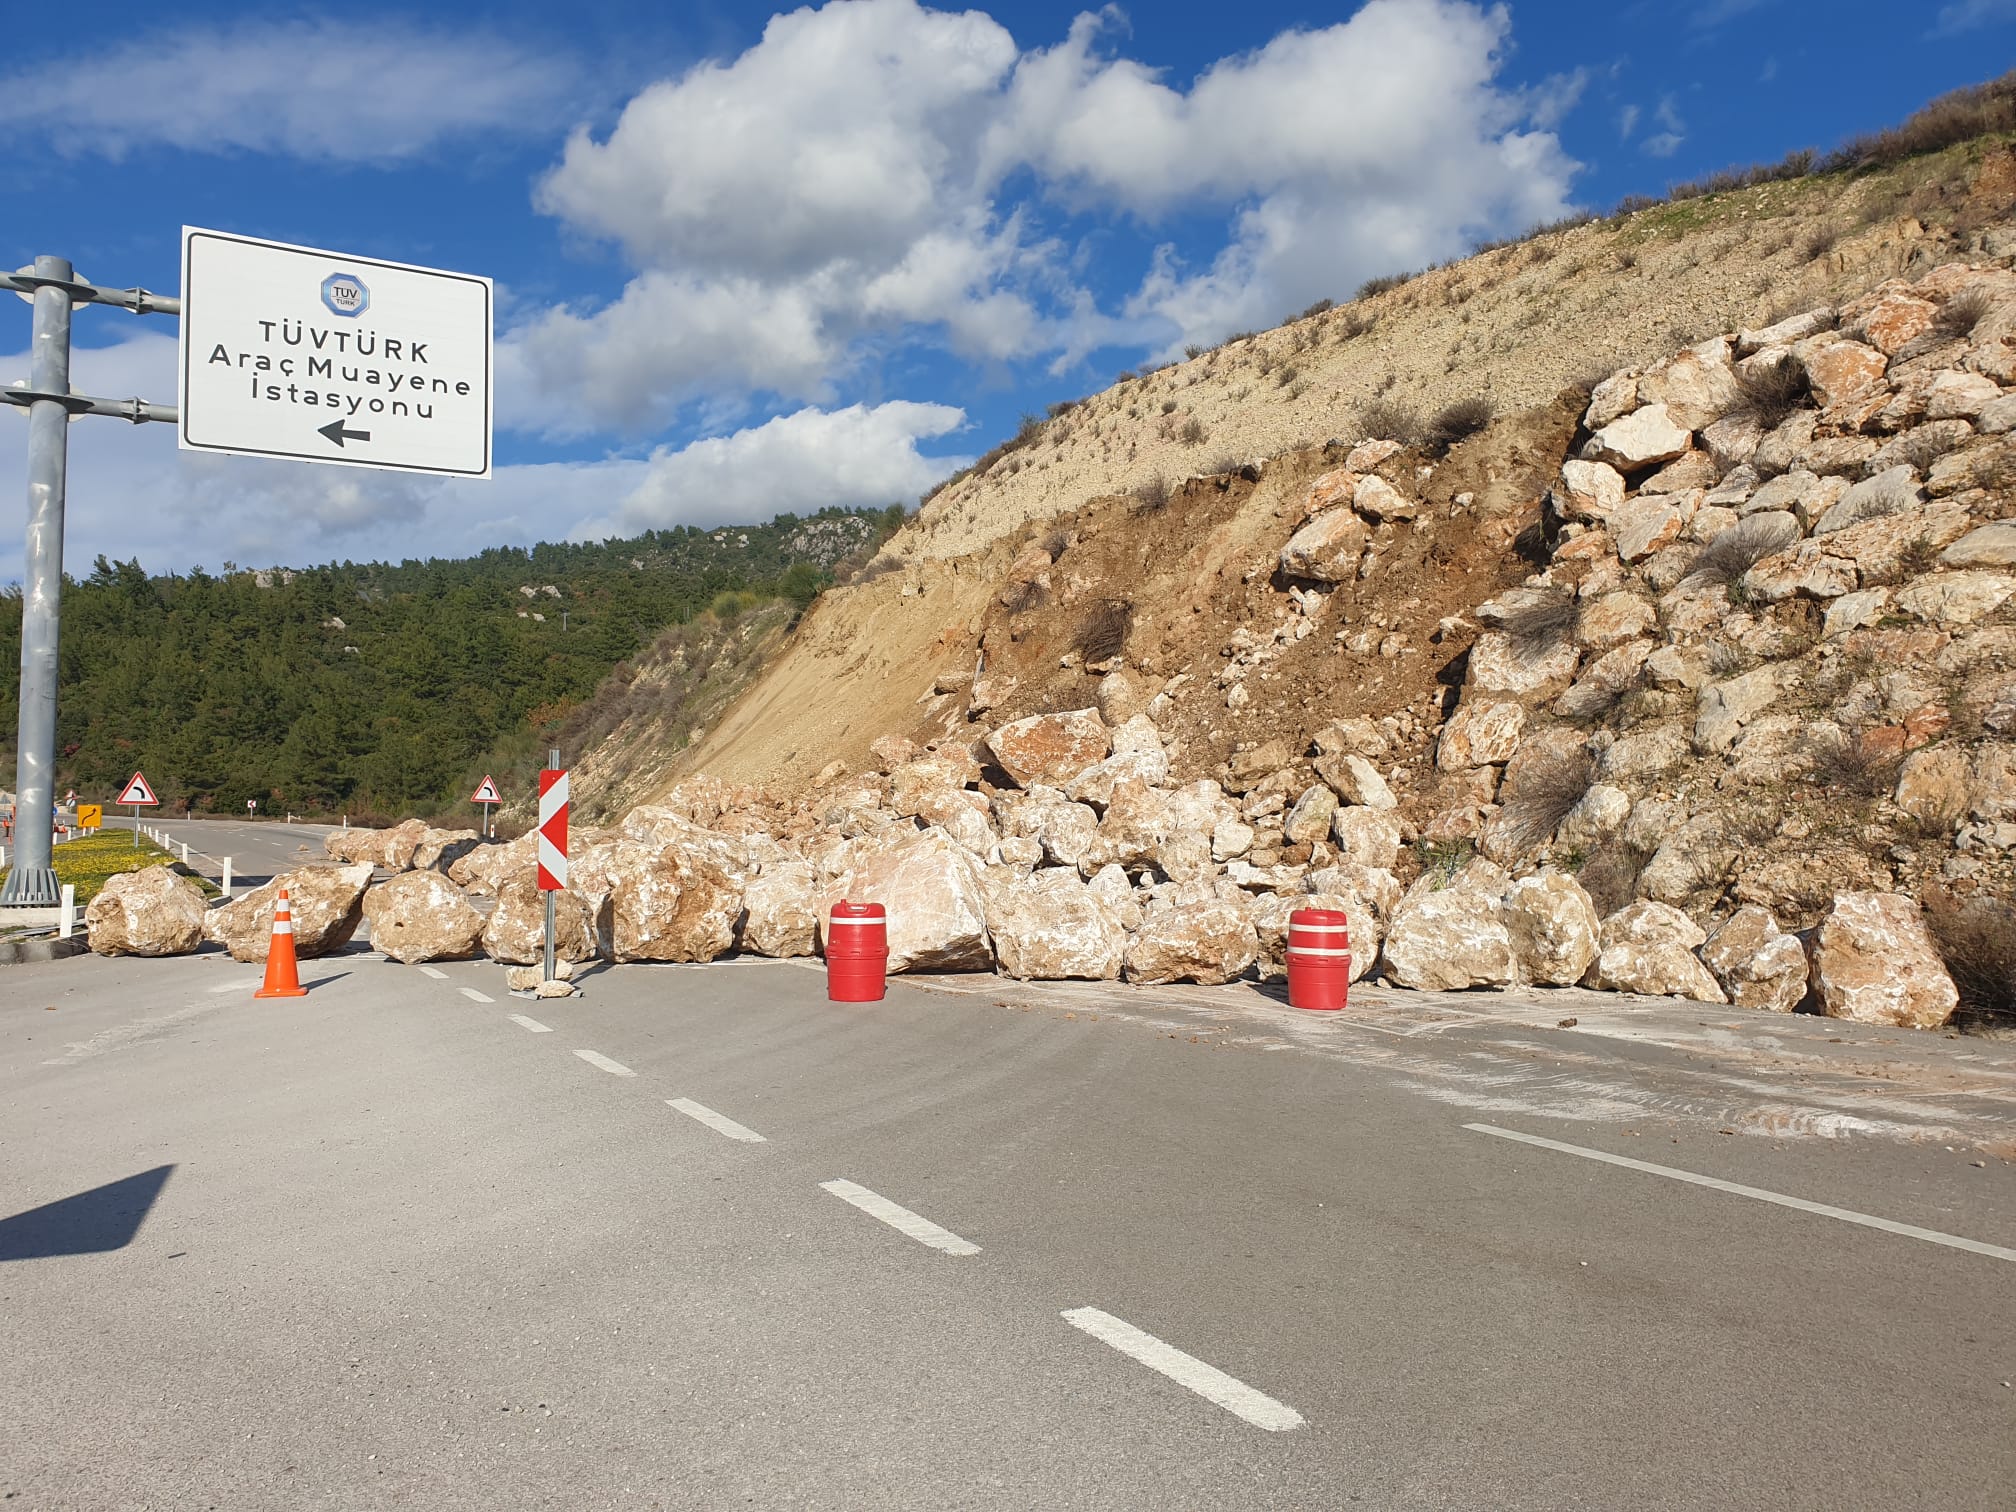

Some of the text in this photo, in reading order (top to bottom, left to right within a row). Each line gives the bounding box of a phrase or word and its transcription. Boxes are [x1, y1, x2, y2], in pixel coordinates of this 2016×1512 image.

[258, 318, 429, 364] TÜVTÜRK
[208, 343, 471, 397] Araç Muayene
[252, 371, 433, 419] İstasyonu
